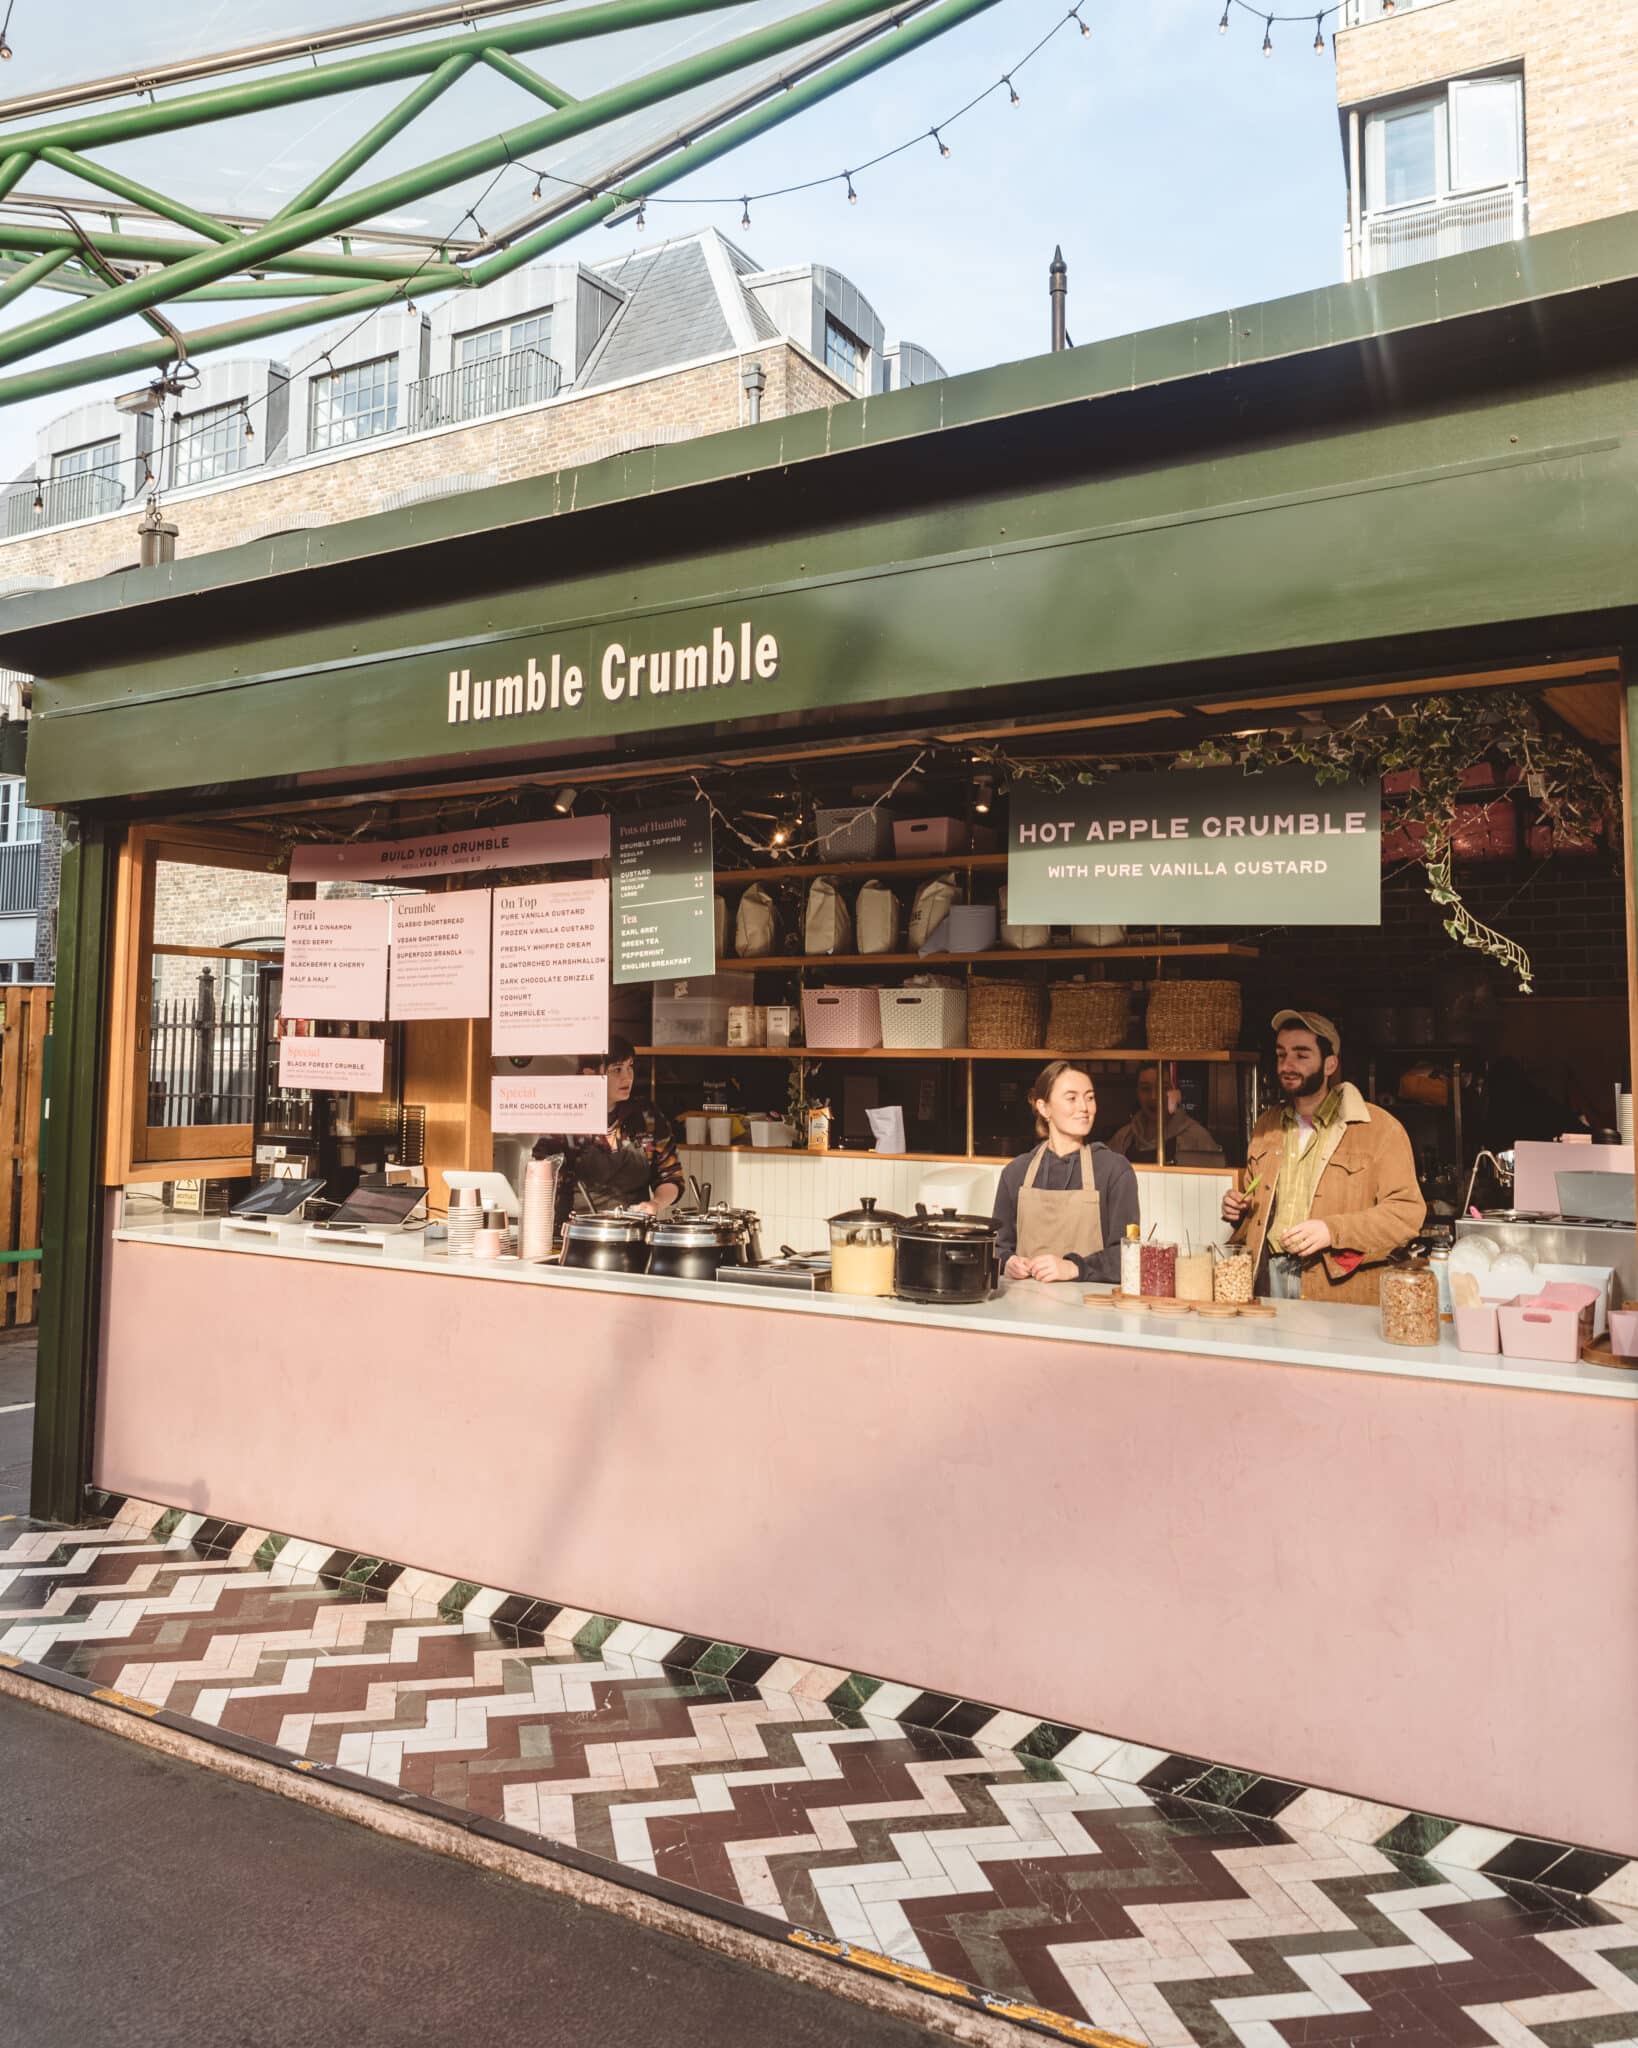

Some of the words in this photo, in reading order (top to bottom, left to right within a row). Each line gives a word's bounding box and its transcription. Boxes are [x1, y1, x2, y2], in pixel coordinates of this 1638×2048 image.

[447, 653, 584, 723] Humble
[601, 621, 779, 701] Crumble
[651, 818, 687, 832] Humble
[1018, 822, 1076, 844] HOT
[1086, 817, 1190, 842] APPLE
[1201, 811, 1367, 839] CRUMBLE
[381, 846, 414, 863] BUILD
[418, 844, 449, 859] YOUR
[452, 836, 510, 854] CRUMBLE
[620, 868, 651, 879] CUSTARD
[1048, 863, 1089, 879] WITH
[1094, 863, 1144, 878] PURE
[1150, 862, 1228, 877] VANILLA
[1234, 860, 1328, 875] CUSTARD
[397, 902, 437, 915] Crumble
[500, 898, 515, 909] On
[518, 896, 537, 910] Top
[293, 909, 316, 921] Fruit
[500, 913, 520, 921] PURE
[521, 911, 550, 919] VANILLA
[551, 908, 586, 917] CUSTARD
[622, 914, 638, 925] Tea
[501, 928, 528, 936] FROZEN
[530, 927, 559, 935] VANILLA
[560, 923, 595, 933] CUSTARD
[621, 928, 640, 937] EARL
[640, 925, 659, 934] GREY
[500, 945, 531, 953] FRESHLY
[533, 942, 565, 951] WHIPPED
[566, 941, 592, 949] CREAM
[621, 939, 645, 948] GREEN
[645, 937, 660, 945] TEA
[397, 951, 433, 959] SUPERFOOD
[621, 948, 665, 959] PEPPERMINT
[290, 961, 332, 969] BLACKBERRY
[500, 959, 551, 969] BLOWTORCHED
[552, 957, 606, 967] MARSHMALLOW
[621, 960, 650, 971] ENGLISH
[651, 957, 692, 968] BREAKFAST
[500, 977, 519, 985] DARK
[520, 975, 562, 984] CHOCOLATE
[563, 974, 595, 982] DRIZZLE
[500, 993, 532, 1001] YOGHURT
[499, 1086, 537, 1100] Special
